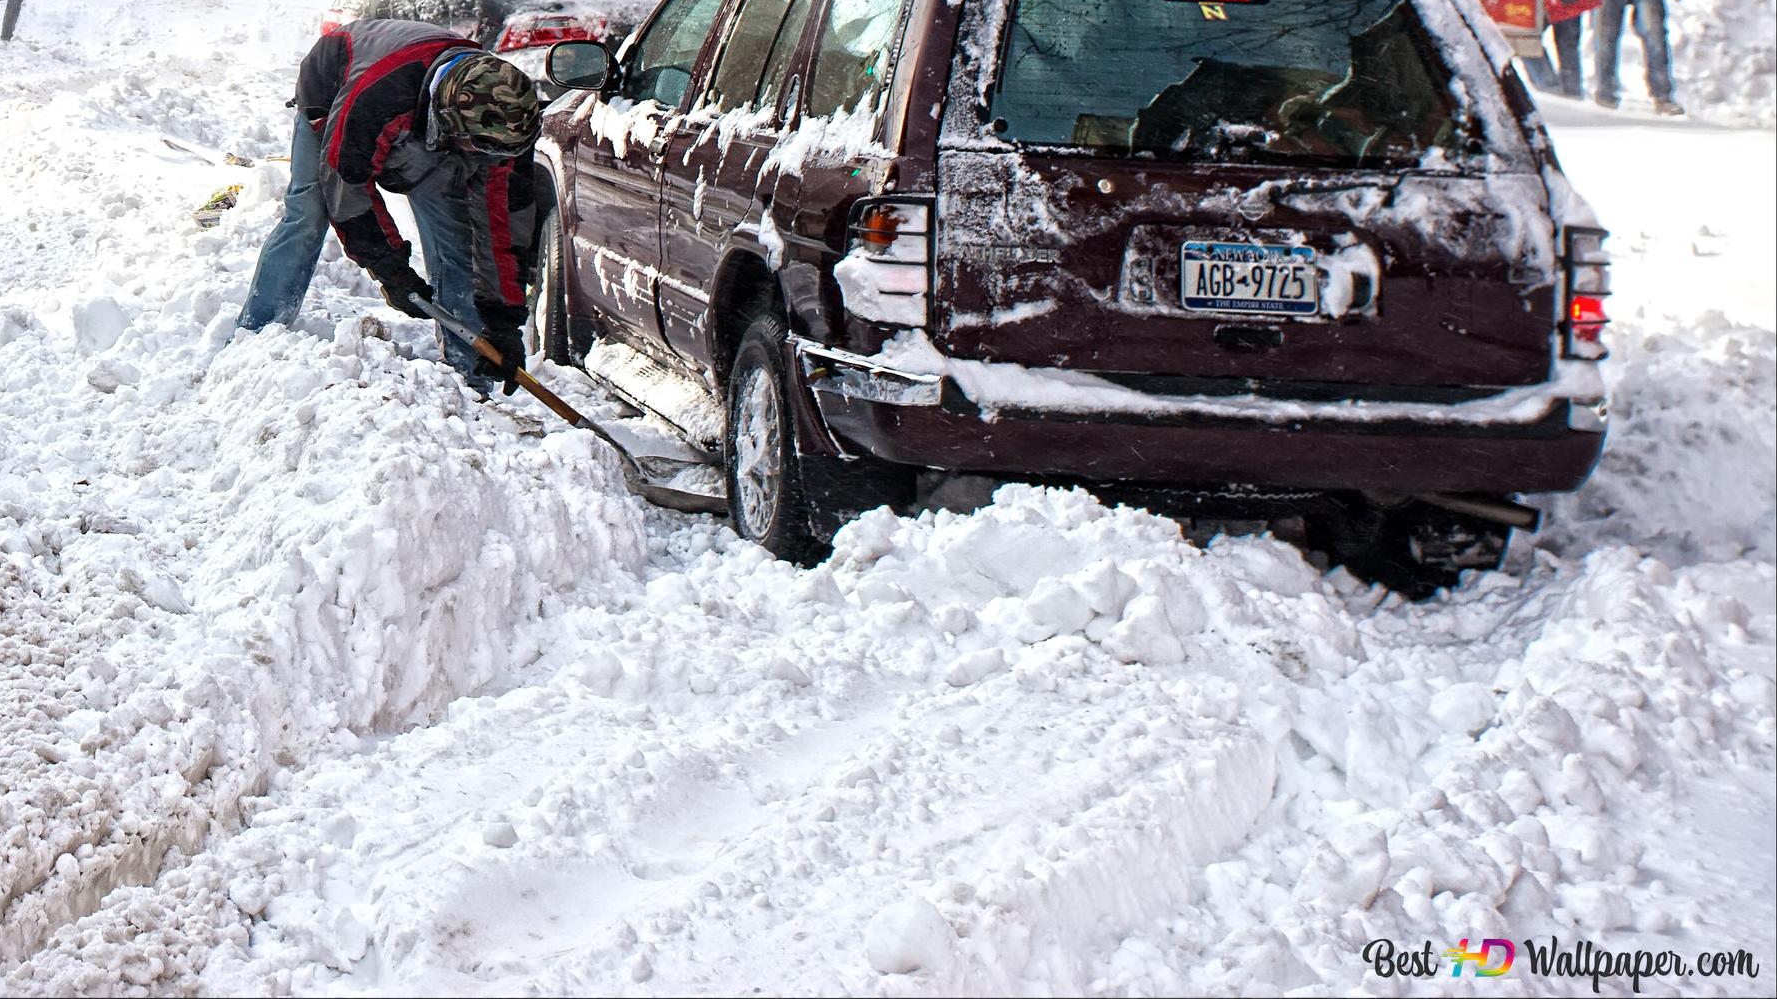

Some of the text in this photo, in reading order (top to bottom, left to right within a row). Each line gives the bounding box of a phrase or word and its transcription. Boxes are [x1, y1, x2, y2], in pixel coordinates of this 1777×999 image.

[1215, 300, 1283, 310] THE EMPIRE STATE
